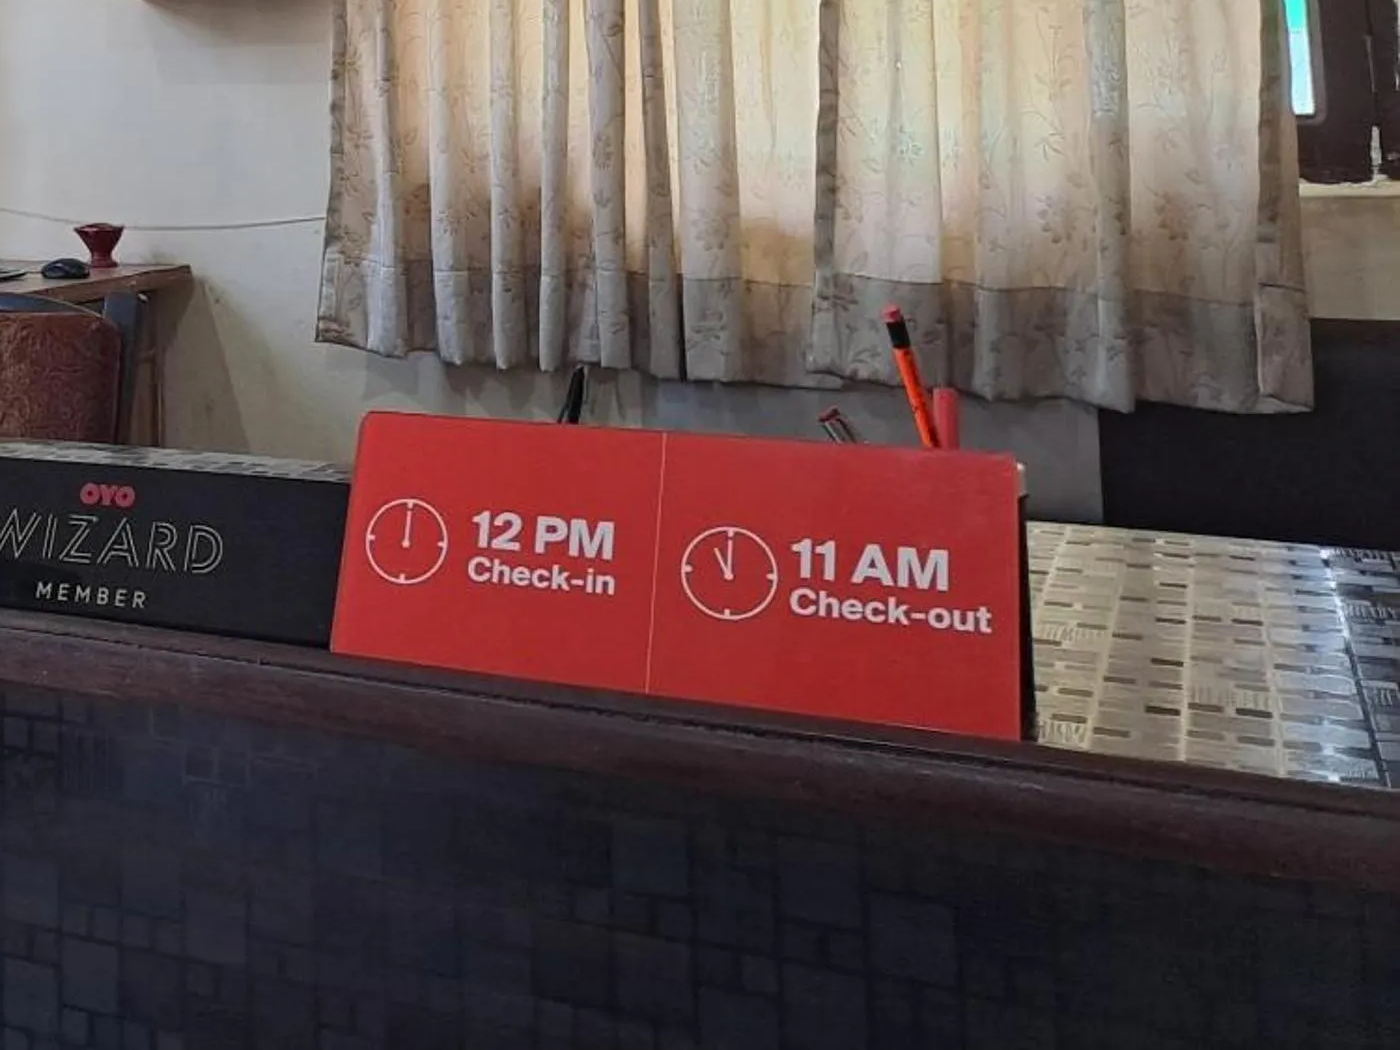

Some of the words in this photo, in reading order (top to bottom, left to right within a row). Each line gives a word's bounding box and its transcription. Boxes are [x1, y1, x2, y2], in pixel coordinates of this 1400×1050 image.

[80, 482, 135, 508] OYO
[471, 509, 523, 551] 12
[534, 514, 616, 561] PM
[466, 555, 616, 595] Check-in
[790, 537, 837, 582] 11
[850, 542, 950, 592] AM
[36, 581, 148, 609] MEMBER
[789, 587, 994, 634] Check-out
